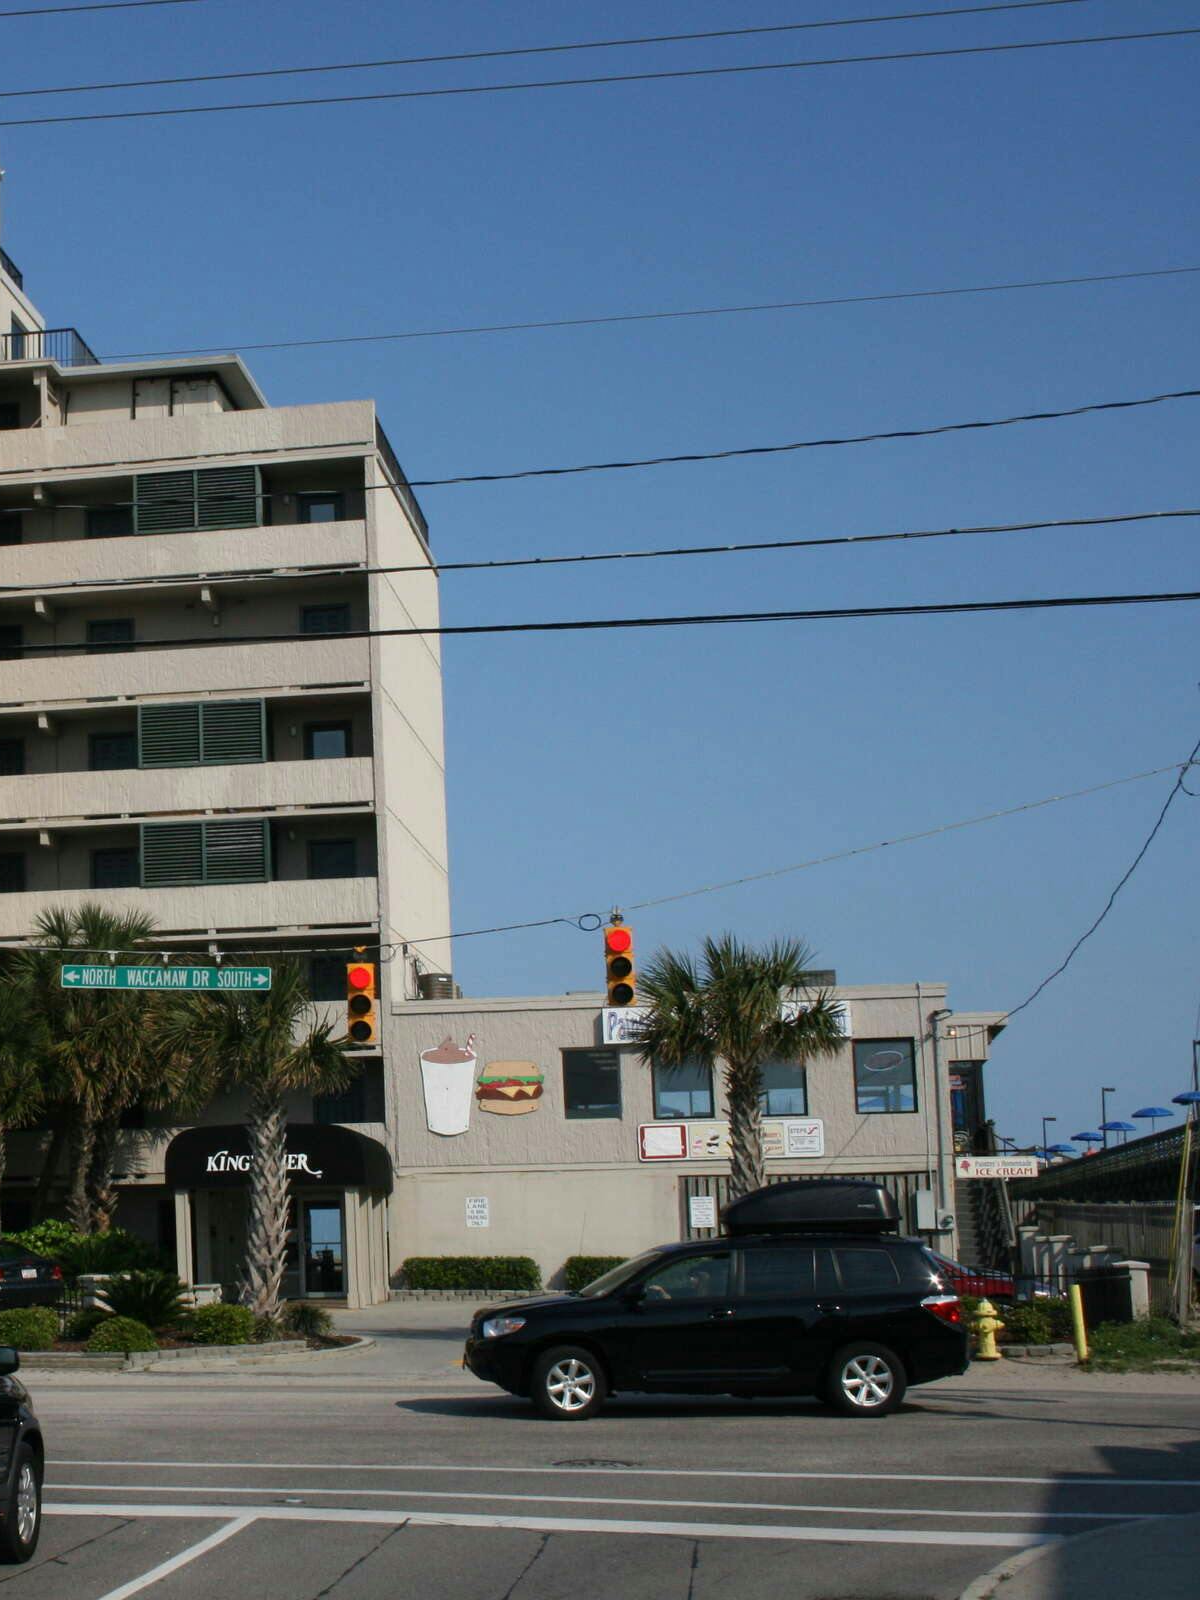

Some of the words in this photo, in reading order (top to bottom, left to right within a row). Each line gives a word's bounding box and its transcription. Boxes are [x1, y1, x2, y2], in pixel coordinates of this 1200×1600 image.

[82, 969, 116, 985] NORTH
[127, 970, 188, 987] WACCAMAW
[192, 970, 209, 987] DR
[217, 970, 252, 988] SOUTH
[206, 1150, 323, 1175] KINGER
[975, 1167, 992, 1176] ICE
[996, 1167, 1033, 1176] CREAM
